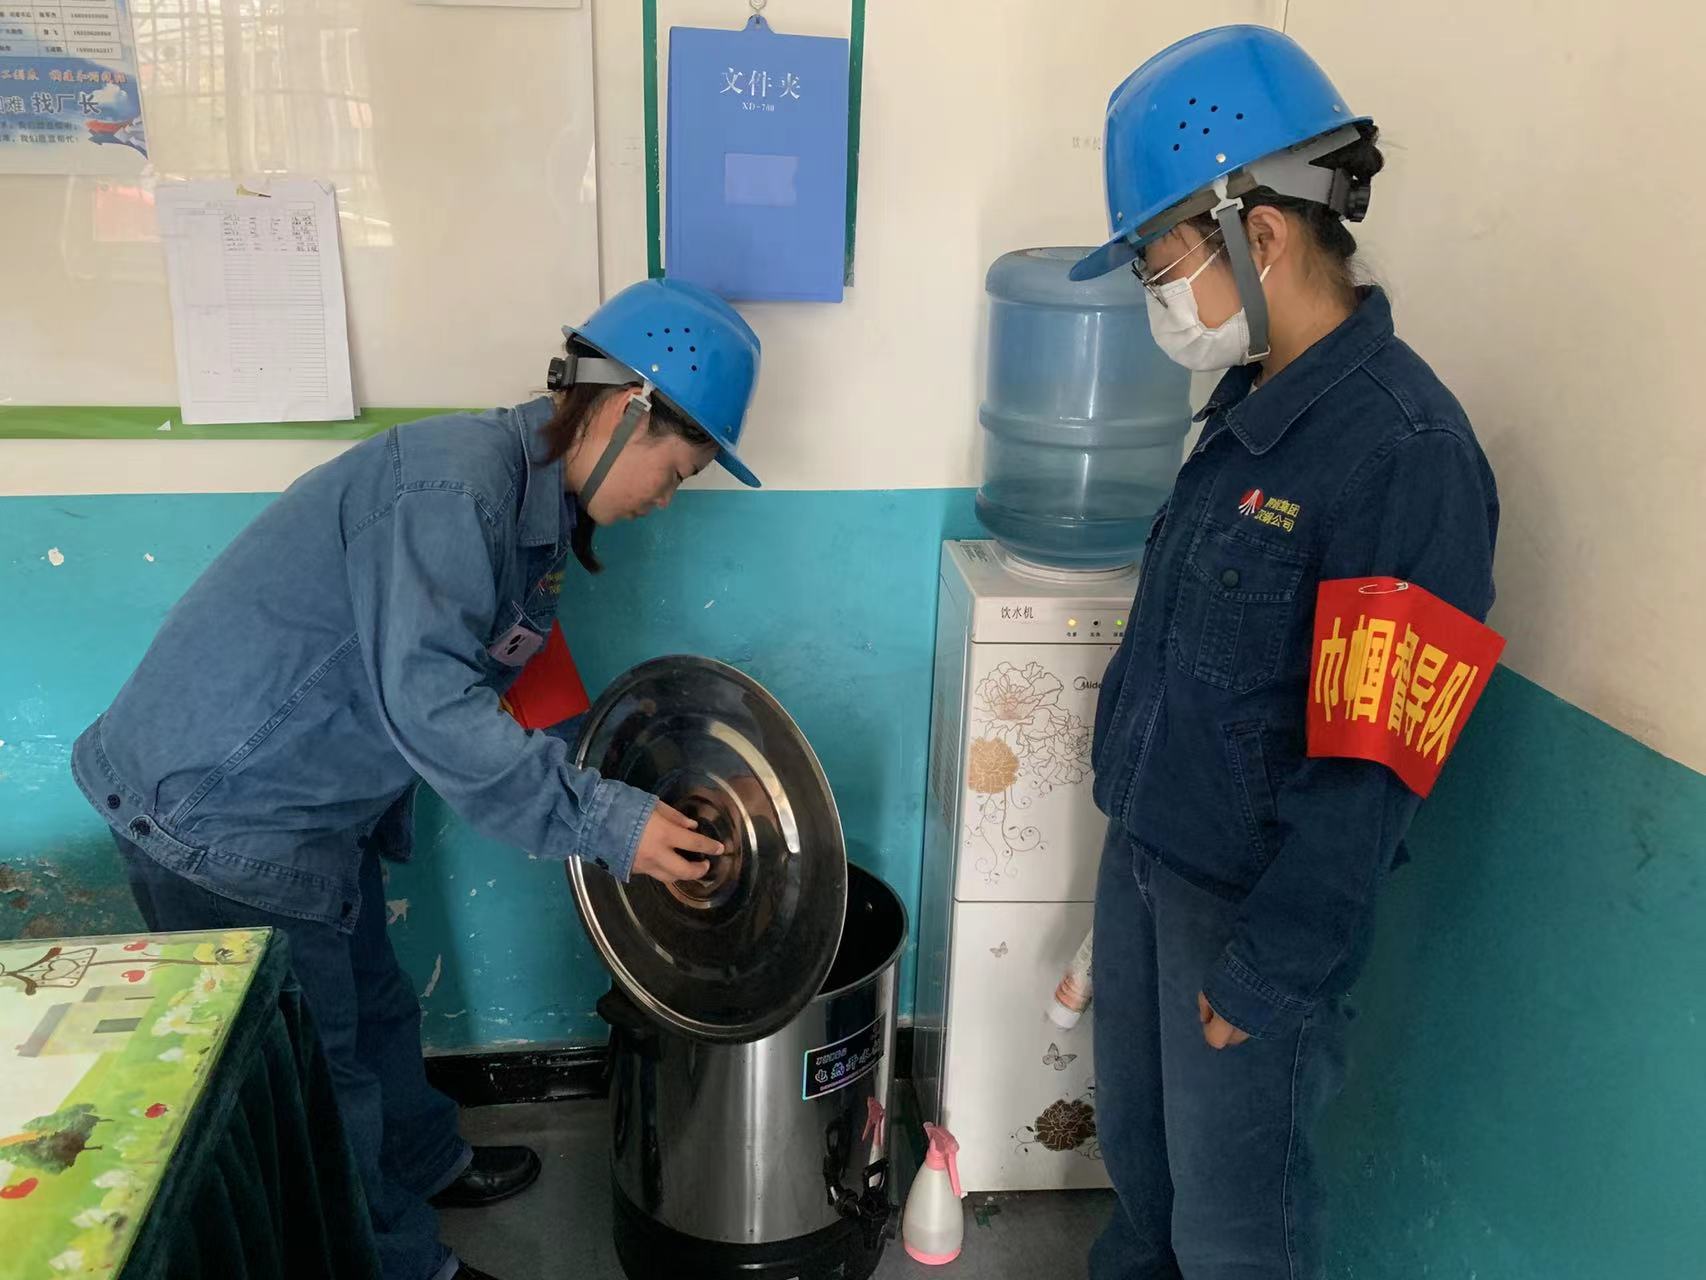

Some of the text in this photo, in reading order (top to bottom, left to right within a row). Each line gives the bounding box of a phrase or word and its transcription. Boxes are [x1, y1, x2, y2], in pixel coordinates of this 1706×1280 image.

[720, 67, 800, 99] 文件夹
[0, 91, 102, 116] 难找厂长
[1001, 605, 1034, 619] 饮水机
[1315, 614, 1479, 765] 巾帼督导队
